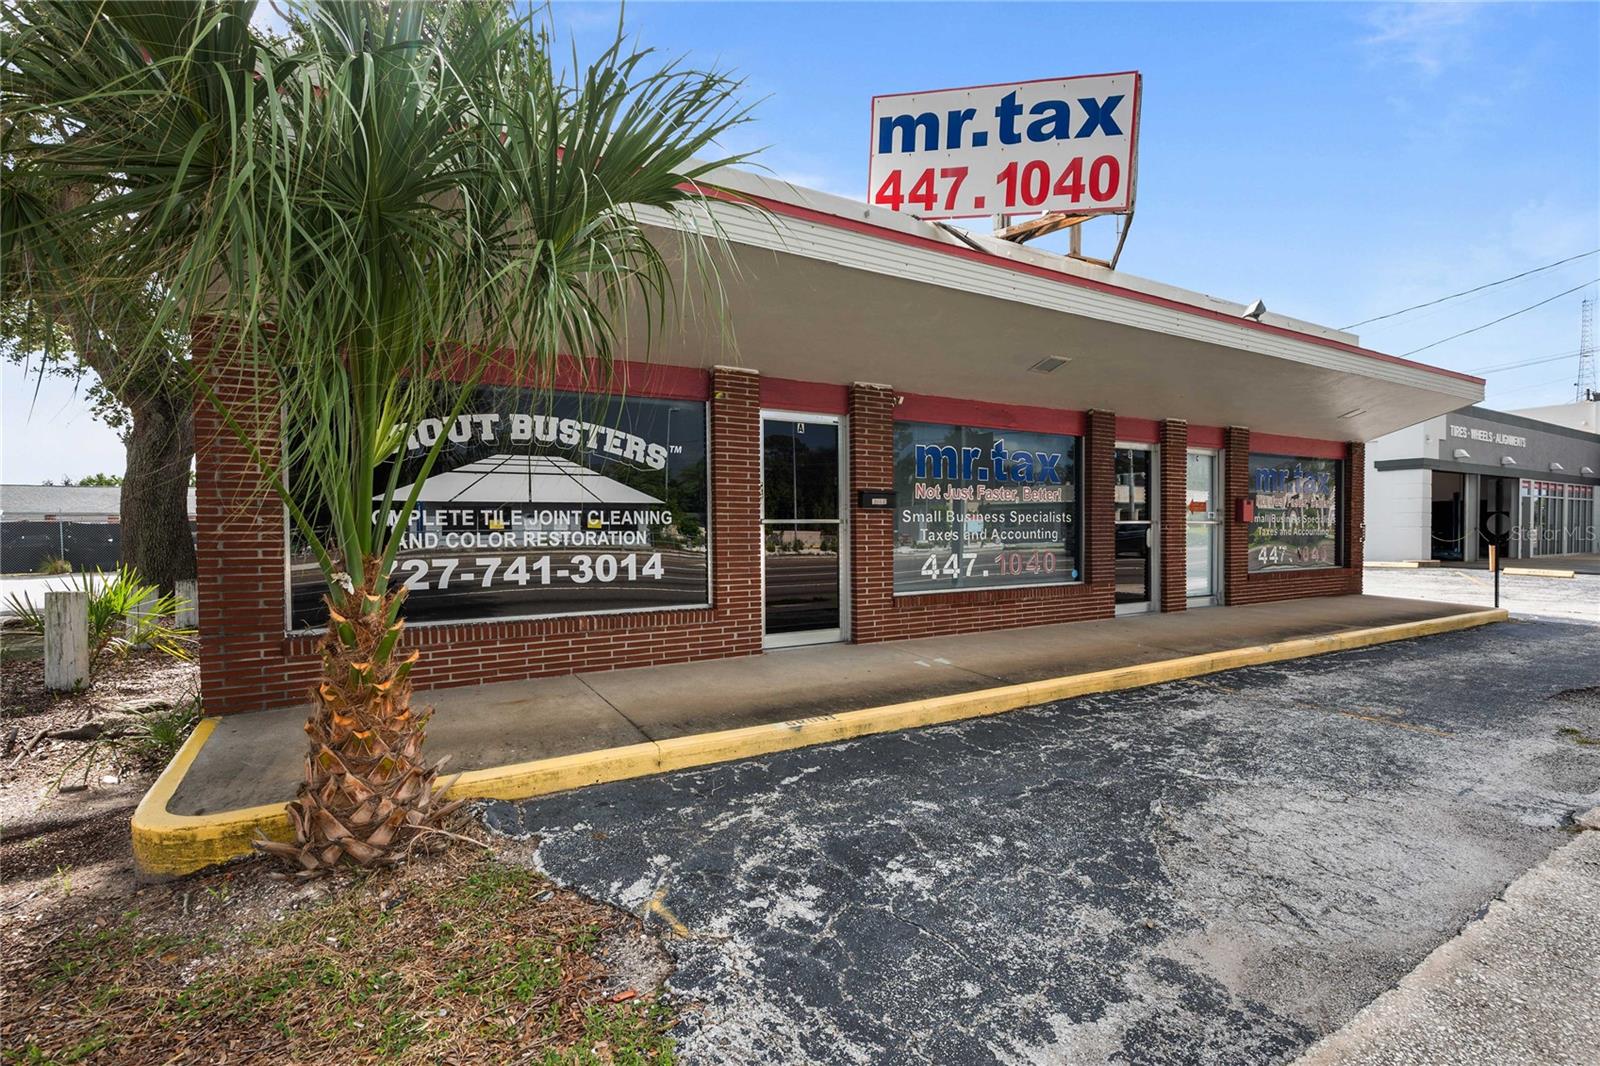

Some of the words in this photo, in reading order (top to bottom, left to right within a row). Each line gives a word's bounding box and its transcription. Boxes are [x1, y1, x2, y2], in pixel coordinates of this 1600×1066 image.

[878, 90, 1126, 154] mr.tax
[509, 414, 668, 471] BUSTERS
[1450, 425, 1468, 439] TIRES
[1470, 429, 1493, 442] WHEELS
[1495, 433, 1527, 448] ALIGNMENTS
[915, 439, 1062, 484] mr.tax
[914, 483, 941, 500] Not
[943, 484, 973, 500] Just
[1022, 486, 1062, 503] Better!
[371, 510, 474, 527] OMPLETE
[481, 510, 522, 526] TILE
[529, 510, 582, 526] JOINT
[589, 510, 673, 526] CLEANING
[902, 510, 941, 524] Small
[946, 510, 1006, 524] Business
[1010, 510, 1072, 525] Specialists
[446, 531, 517, 549] COLOR
[523, 530, 647, 548] RESTORATION
[920, 528, 959, 542] Taxes
[964, 529, 987, 541] and
[991, 528, 1059, 542] Accounting
